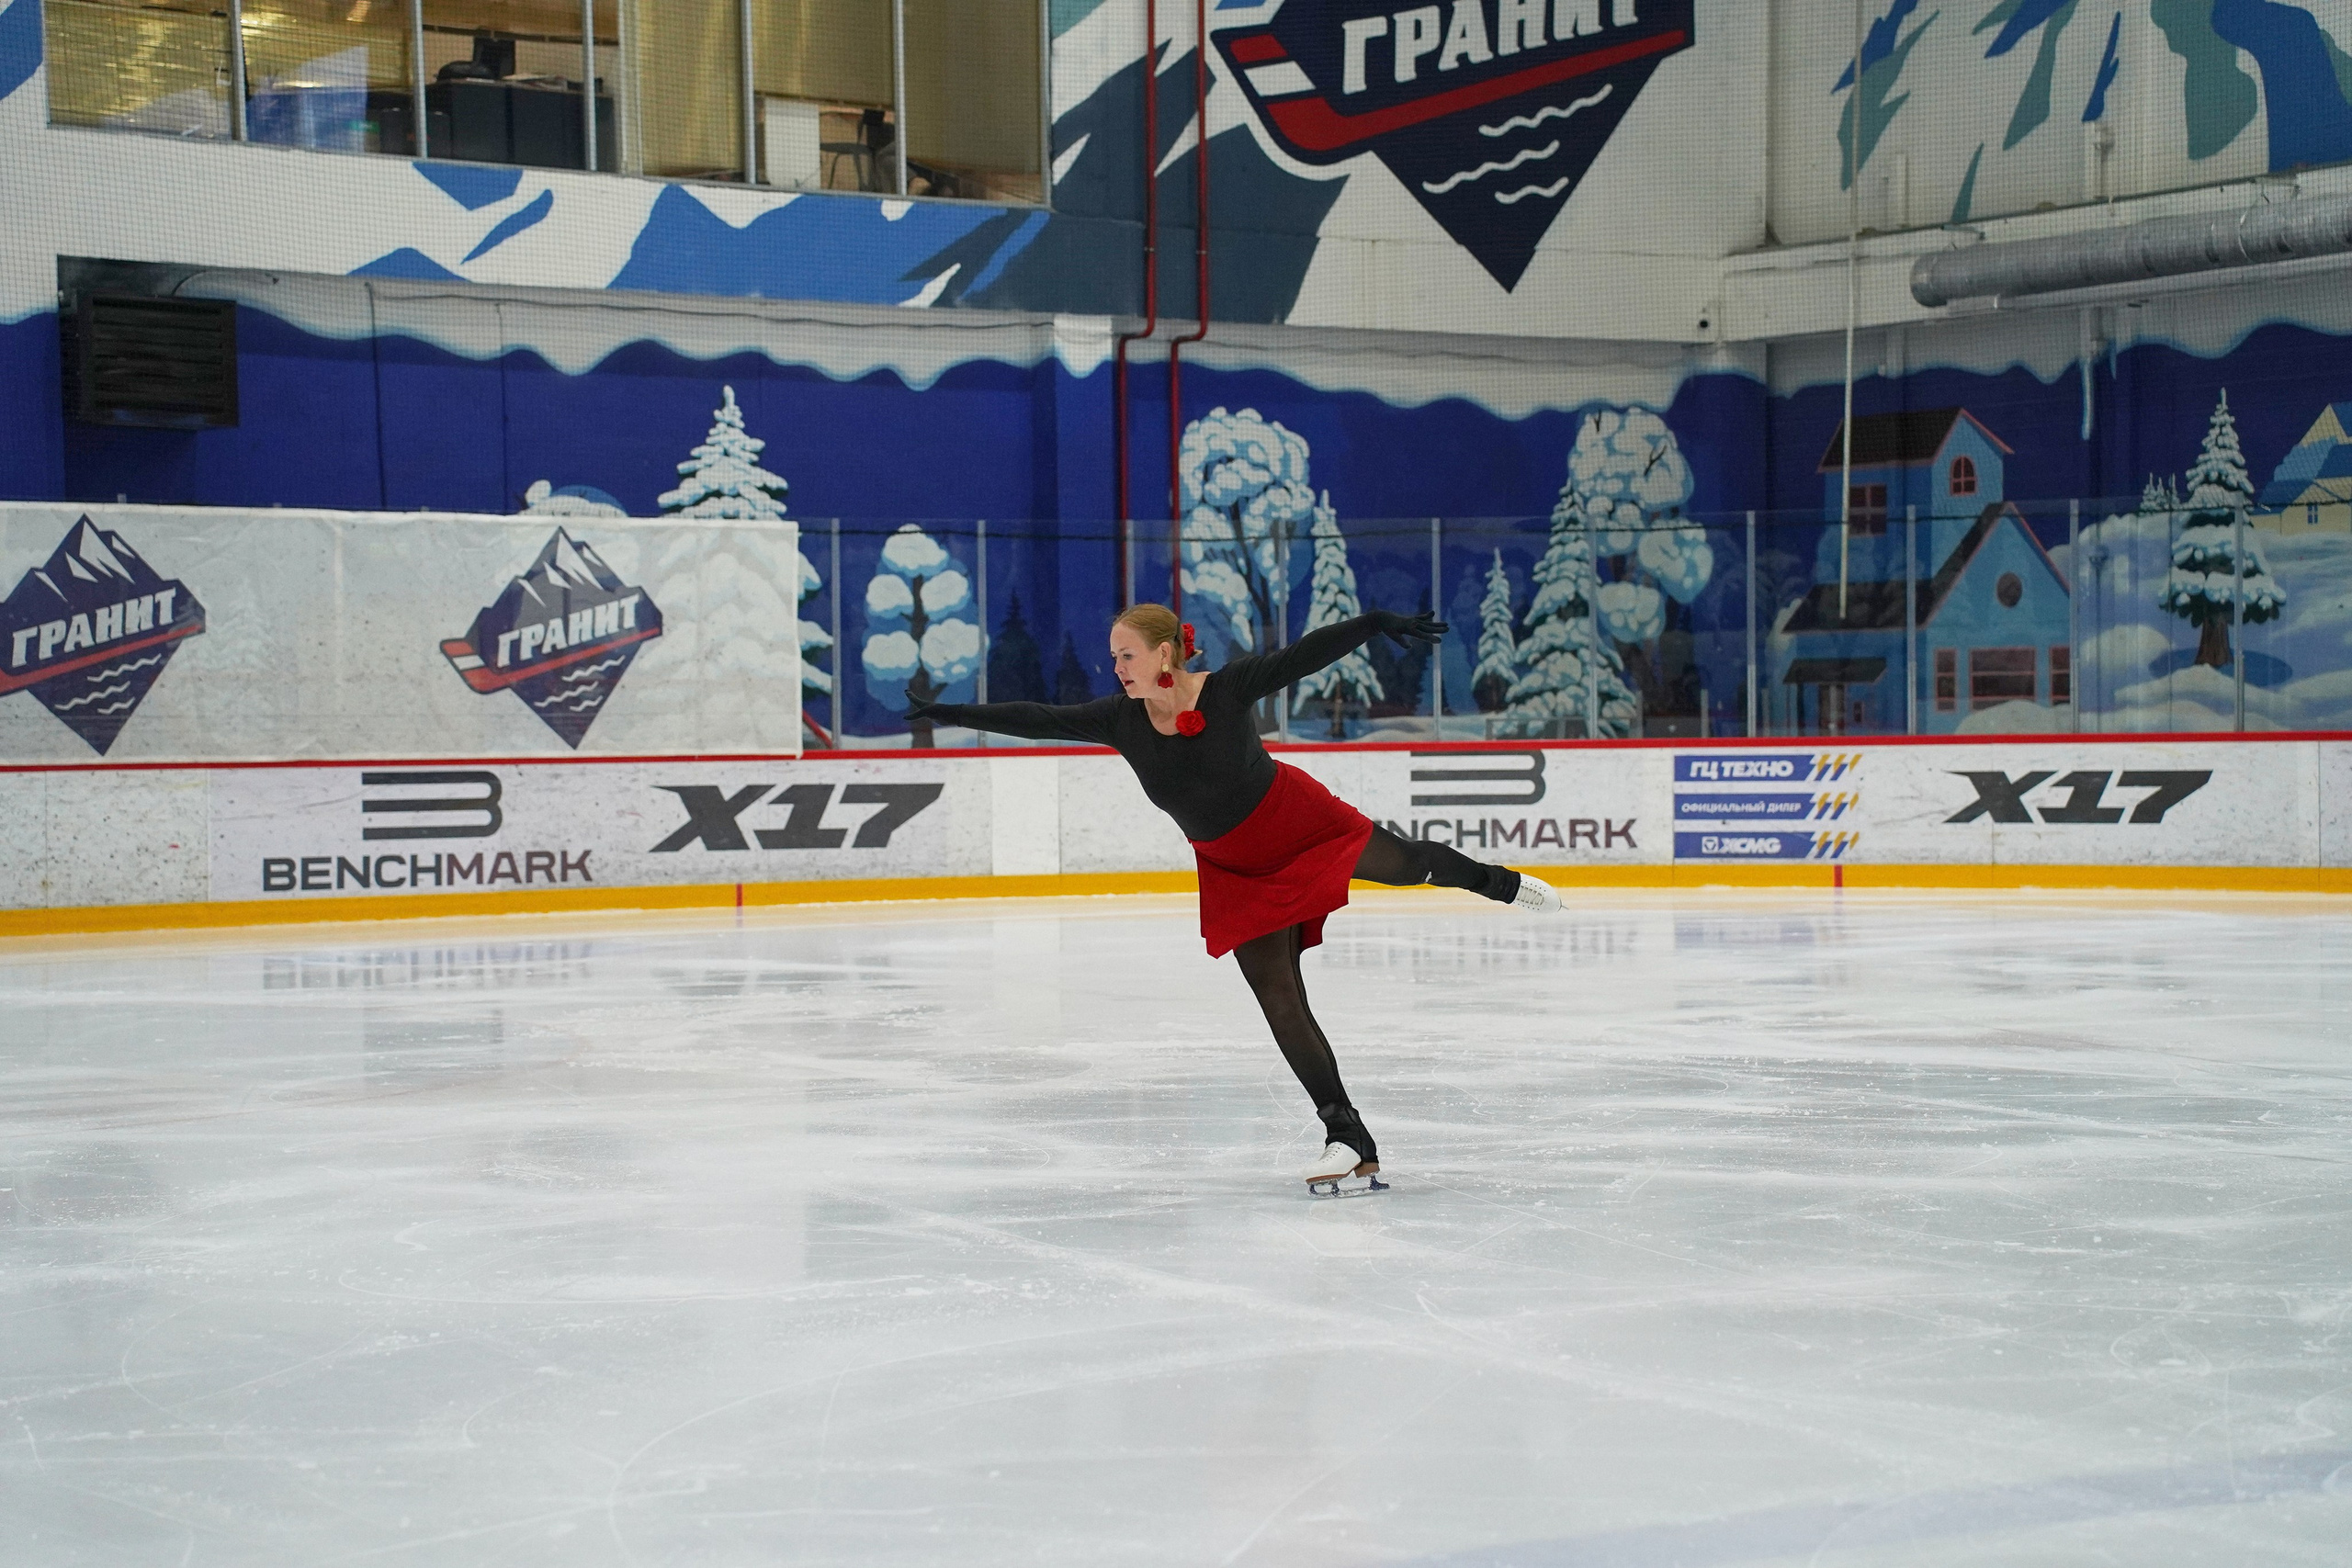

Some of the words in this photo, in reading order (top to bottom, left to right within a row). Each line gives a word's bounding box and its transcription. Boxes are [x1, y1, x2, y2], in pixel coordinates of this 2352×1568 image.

[12, 587, 177, 668] ГРАНИТ
[496, 592, 641, 668] ГРАНИТ
[1689, 760, 1719, 781] ГЦ
[1721, 759, 1795, 778] ТЕХНО
[1680, 800, 1766, 814] ОФИЦИАЛЬНЫЙ
[1767, 802, 1803, 814] ДИЛЕР
[1944, 770, 2214, 824] X17
[649, 784, 945, 854] X17
[1380, 818, 1638, 849] NCHMARK
[1719, 837, 1782, 854] XCMG
[263, 850, 594, 892] BENCHMARK
